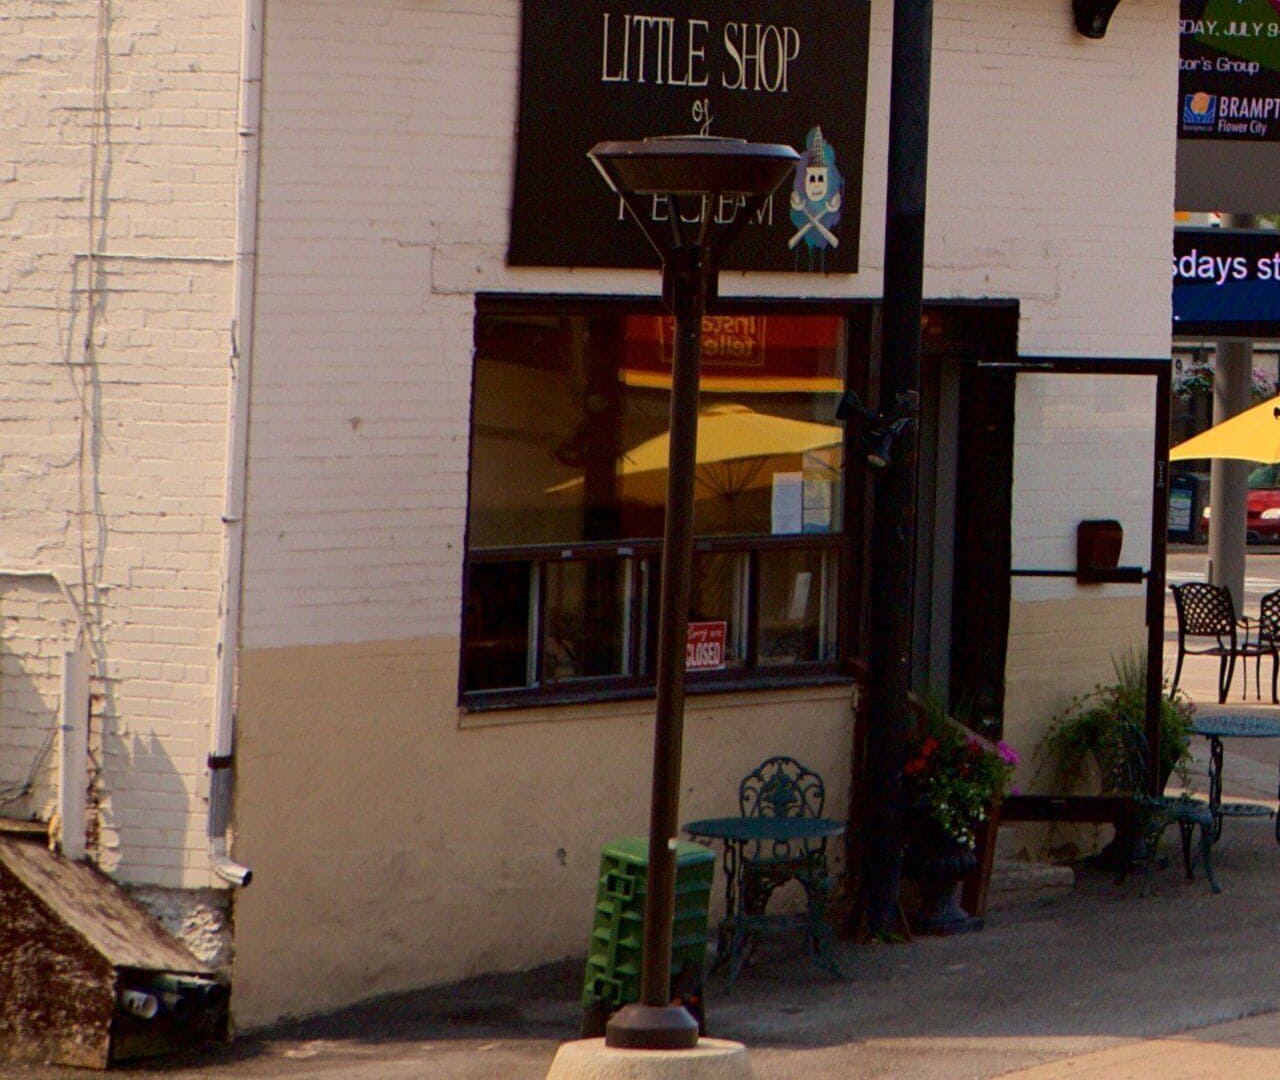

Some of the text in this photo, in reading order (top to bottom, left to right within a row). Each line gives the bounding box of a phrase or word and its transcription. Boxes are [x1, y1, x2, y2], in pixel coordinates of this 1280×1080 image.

[1224, 21, 1263, 37] JULY
[601, 13, 800, 93] LITTLE SHOP
[1216, 57, 1259, 76] Group
[692, 98, 714, 135] of
[1218, 119, 1248, 133] Flower
[1250, 120, 1268, 136] City
